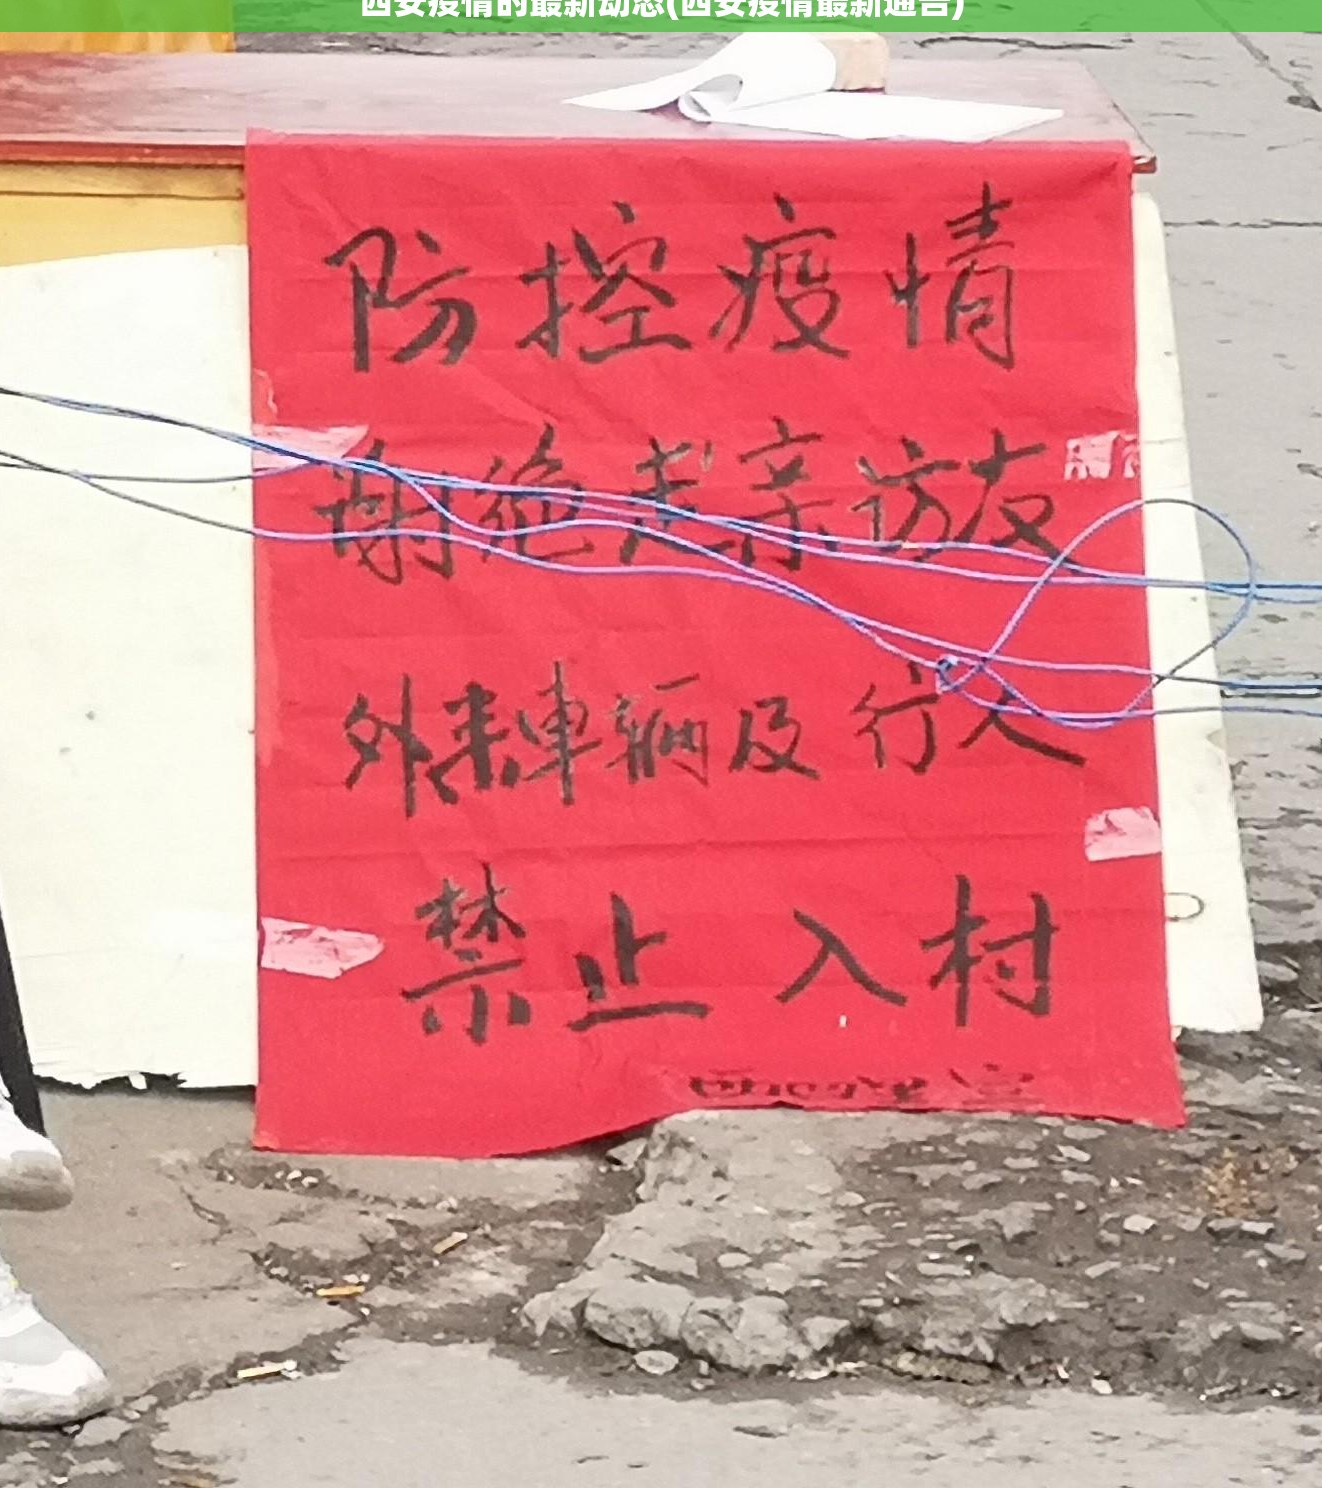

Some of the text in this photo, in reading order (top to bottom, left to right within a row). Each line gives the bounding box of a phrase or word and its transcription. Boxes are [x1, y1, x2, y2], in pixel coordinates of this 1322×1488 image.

[324, 181, 1017, 373] 防控疫情
[317, 417, 1075, 587] 谢绝走亲访友
[402, 863, 1059, 1044] 禁止入村
